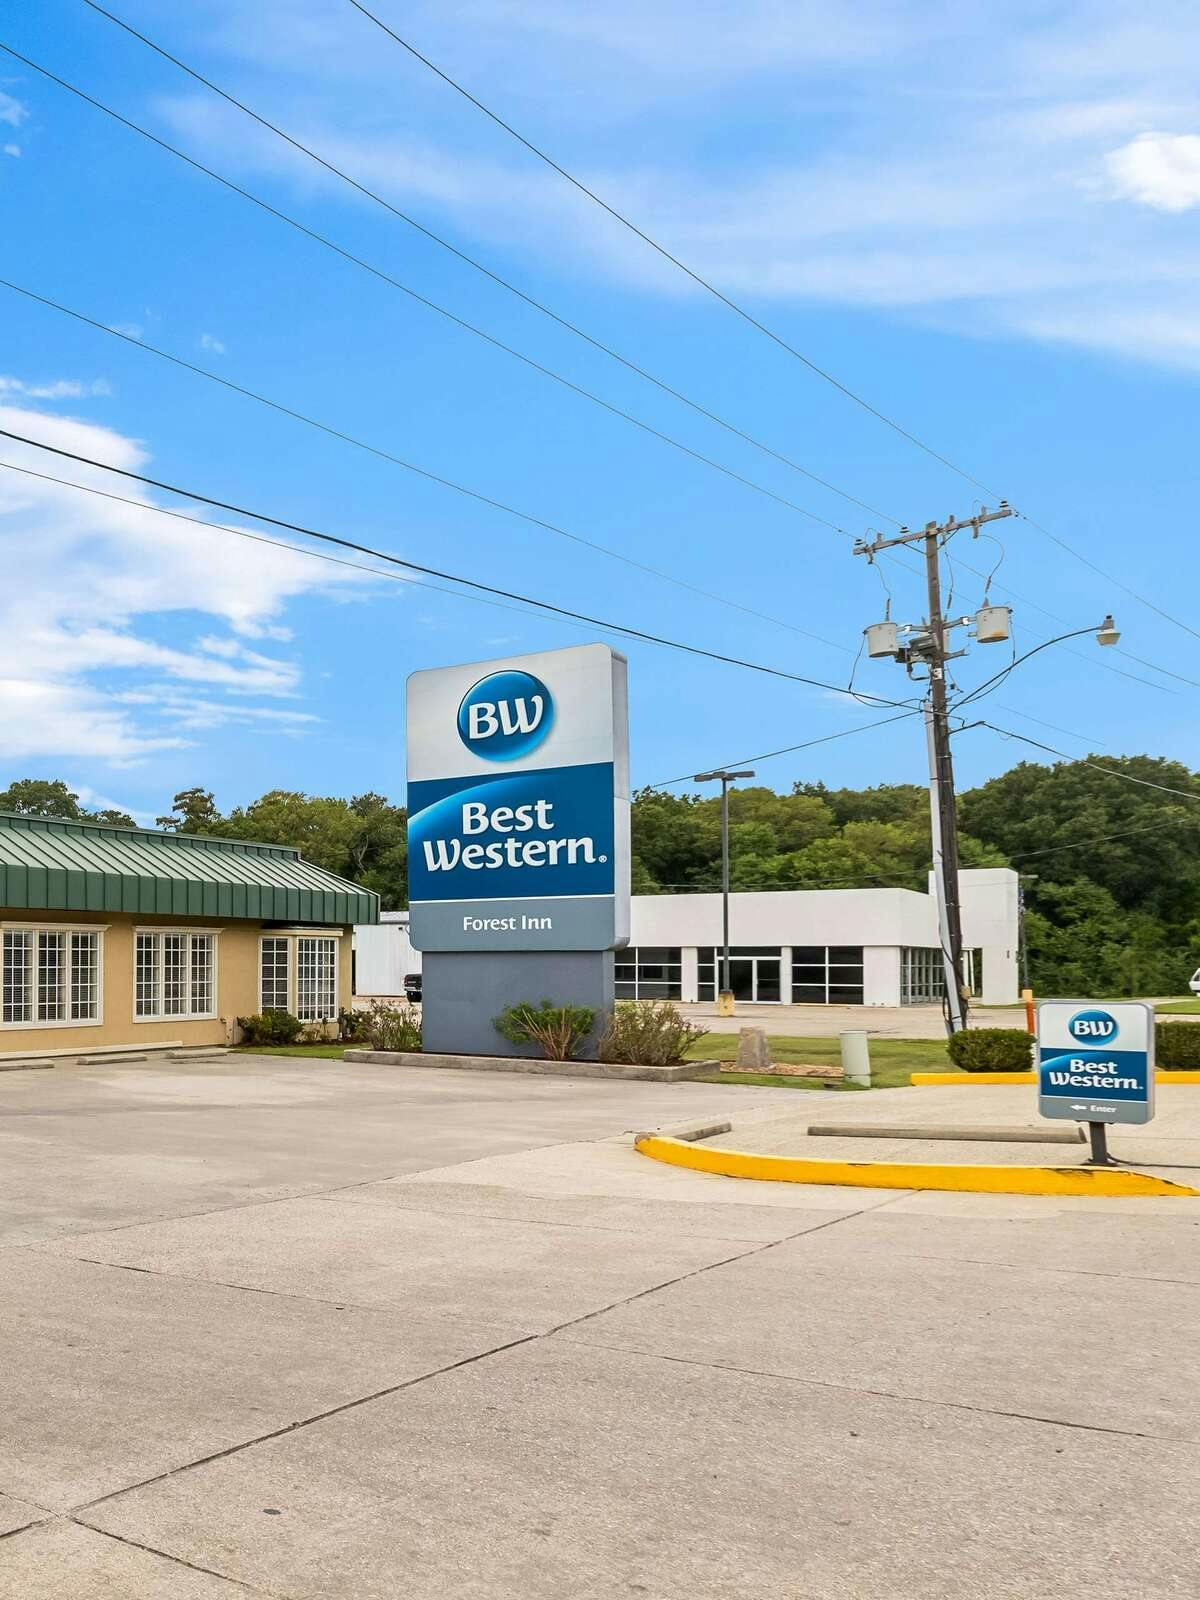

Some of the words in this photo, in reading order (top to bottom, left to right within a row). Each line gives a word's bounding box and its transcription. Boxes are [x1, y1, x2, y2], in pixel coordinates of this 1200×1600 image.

[468, 695, 544, 740] BW
[462, 799, 554, 835] Best
[423, 837, 596, 872] Western
[463, 916, 516, 931] Forest
[521, 915, 553, 930] Inn
[1073, 1020, 1114, 1036] BW
[1070, 1058, 1118, 1075] Best
[1049, 1072, 1138, 1089] Western
[1090, 1104, 1117, 1113] Enter
